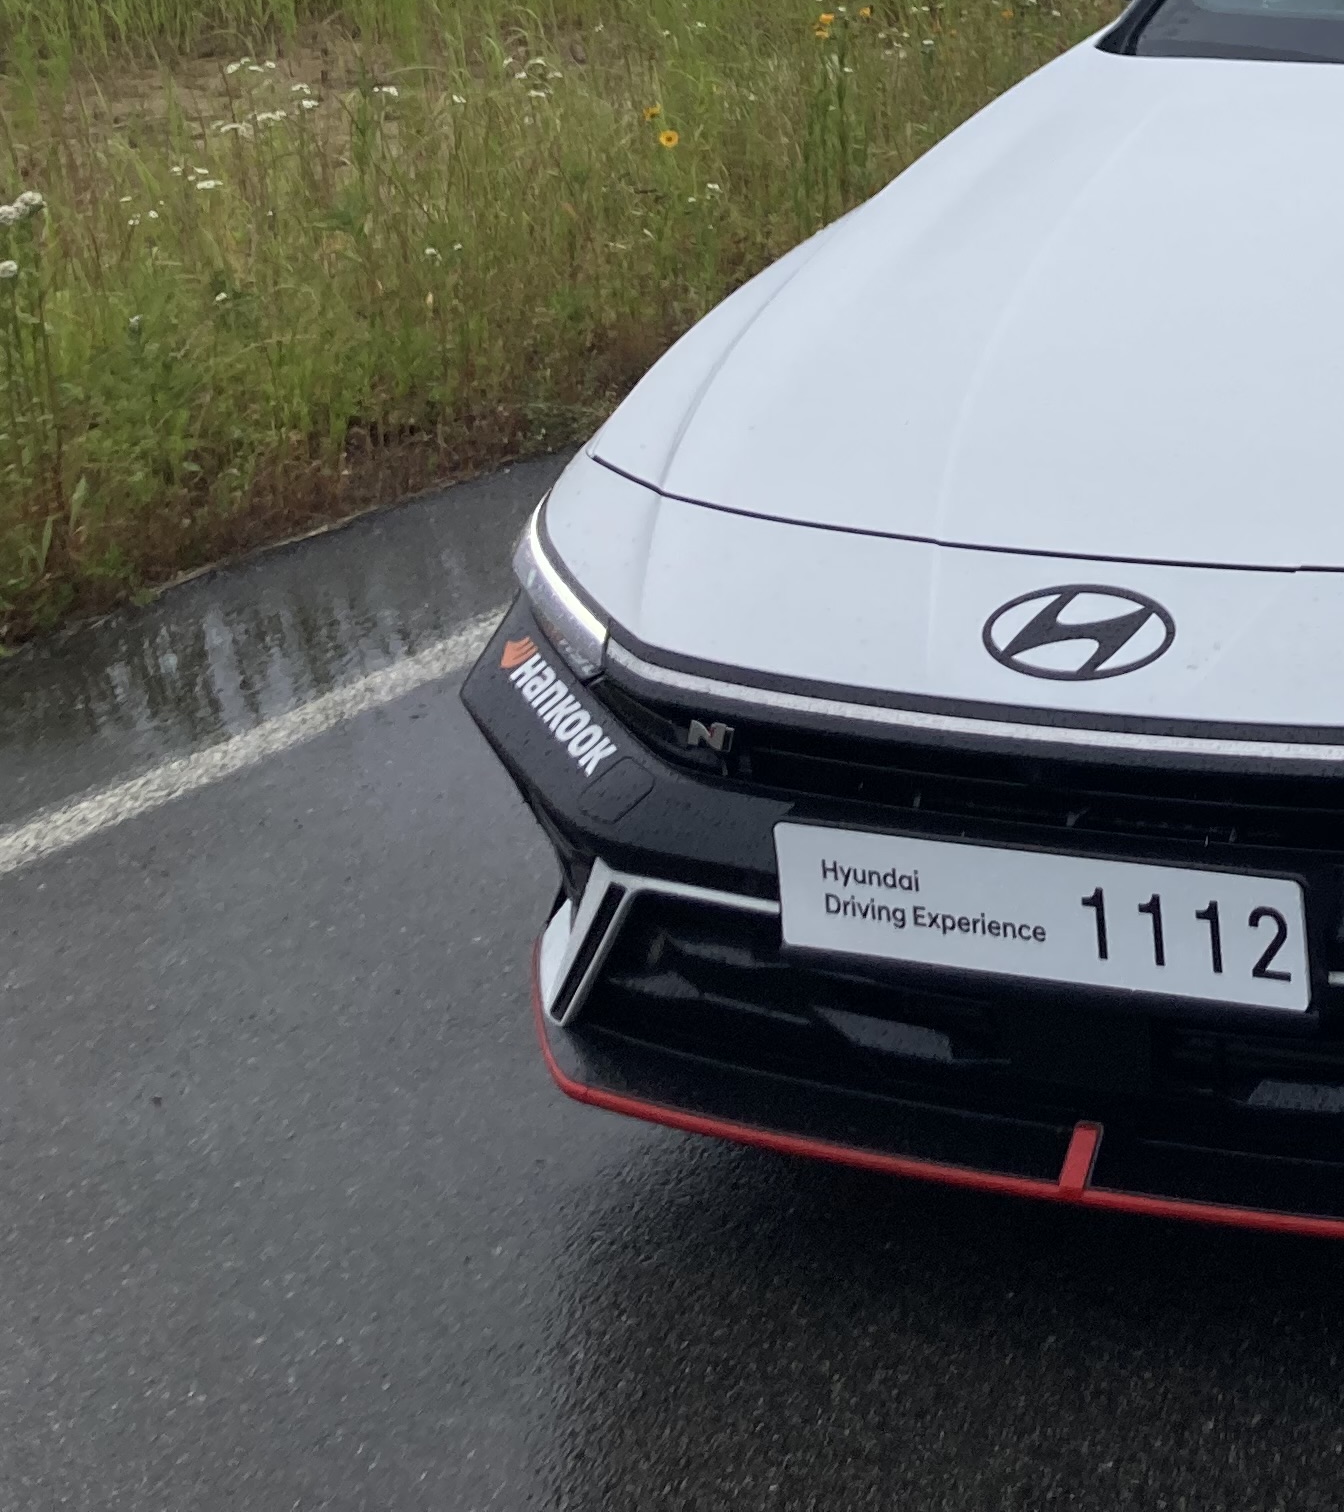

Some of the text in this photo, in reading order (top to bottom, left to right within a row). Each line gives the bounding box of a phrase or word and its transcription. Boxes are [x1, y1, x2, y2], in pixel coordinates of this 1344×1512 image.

[821, 859, 920, 892] Hyundai
[826, 894, 1047, 943] Driving Experience
[1081, 886, 1292, 983] 1112
